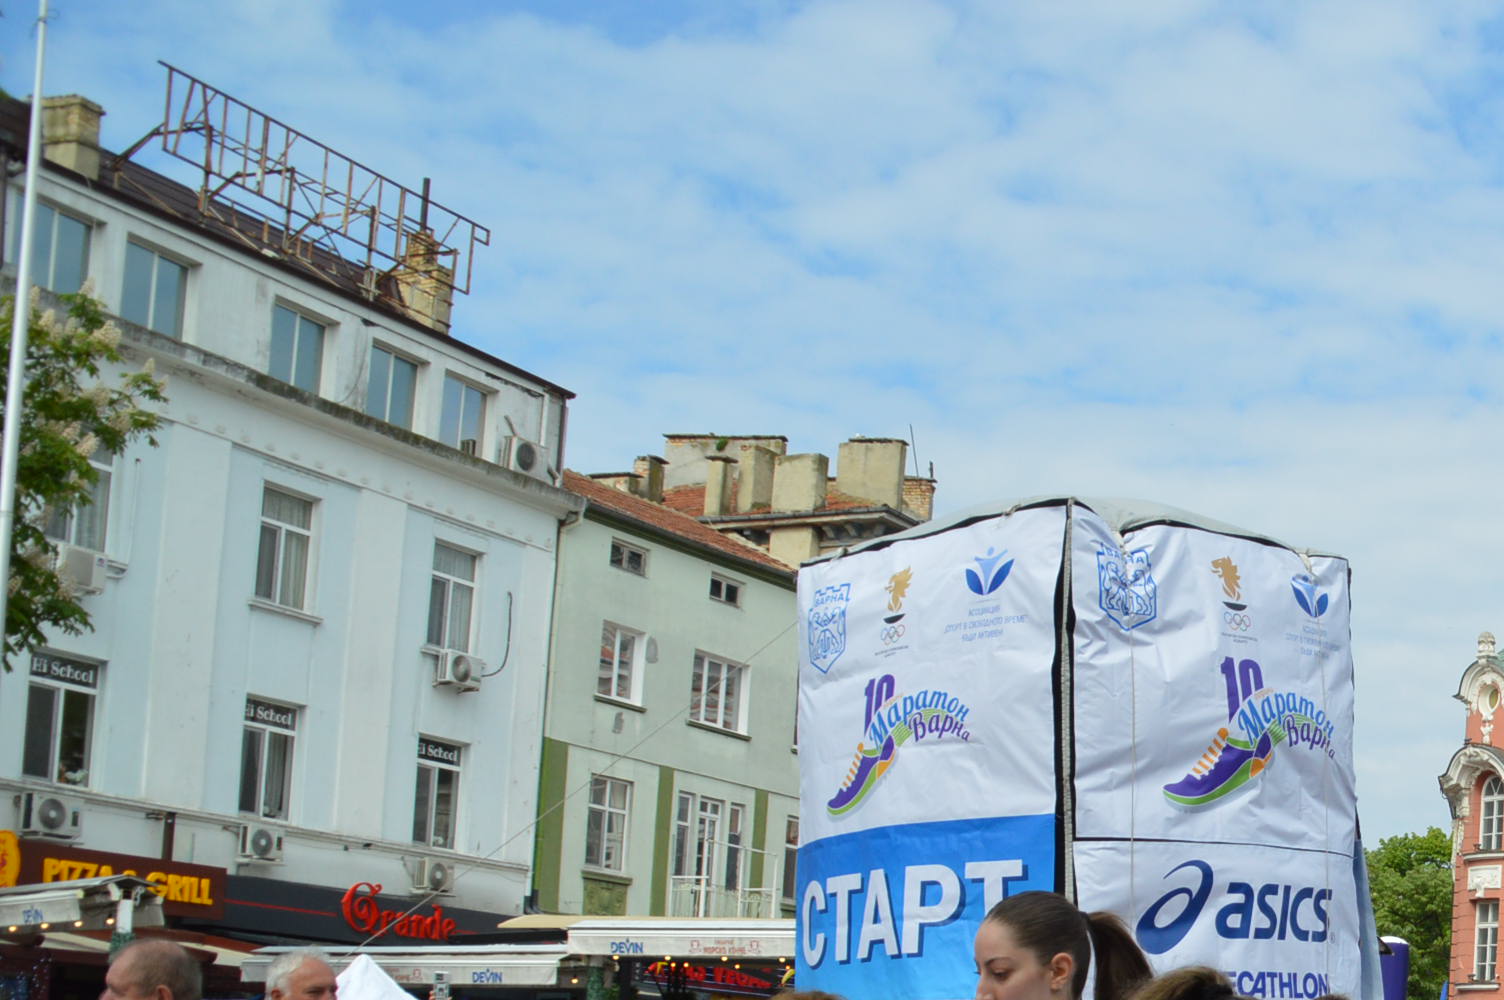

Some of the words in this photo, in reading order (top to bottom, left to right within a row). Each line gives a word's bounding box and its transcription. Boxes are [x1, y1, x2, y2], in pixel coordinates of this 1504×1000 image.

[32, 657, 48, 673] Hi
[50, 660, 94, 683] School
[864, 674, 895, 738] 10
[1220, 656, 1264, 725] 10
[256, 706, 292, 726] School
[870, 689, 970, 750] Маратон
[908, 711, 971, 743] Варна
[1238, 692, 1335, 746] Маратон
[427, 744, 457, 762] School
[1282, 714, 1336, 760] Варна
[146, 871, 214, 905] GRILL
[341, 882, 456, 941] Grande
[802, 859, 1025, 968] СТАРТ
[1215, 882, 1332, 942] asics
[611, 940, 644, 954] DEVIN
[472, 970, 503, 983] DEVIN
[1226, 970, 1331, 999] ECATHLON
